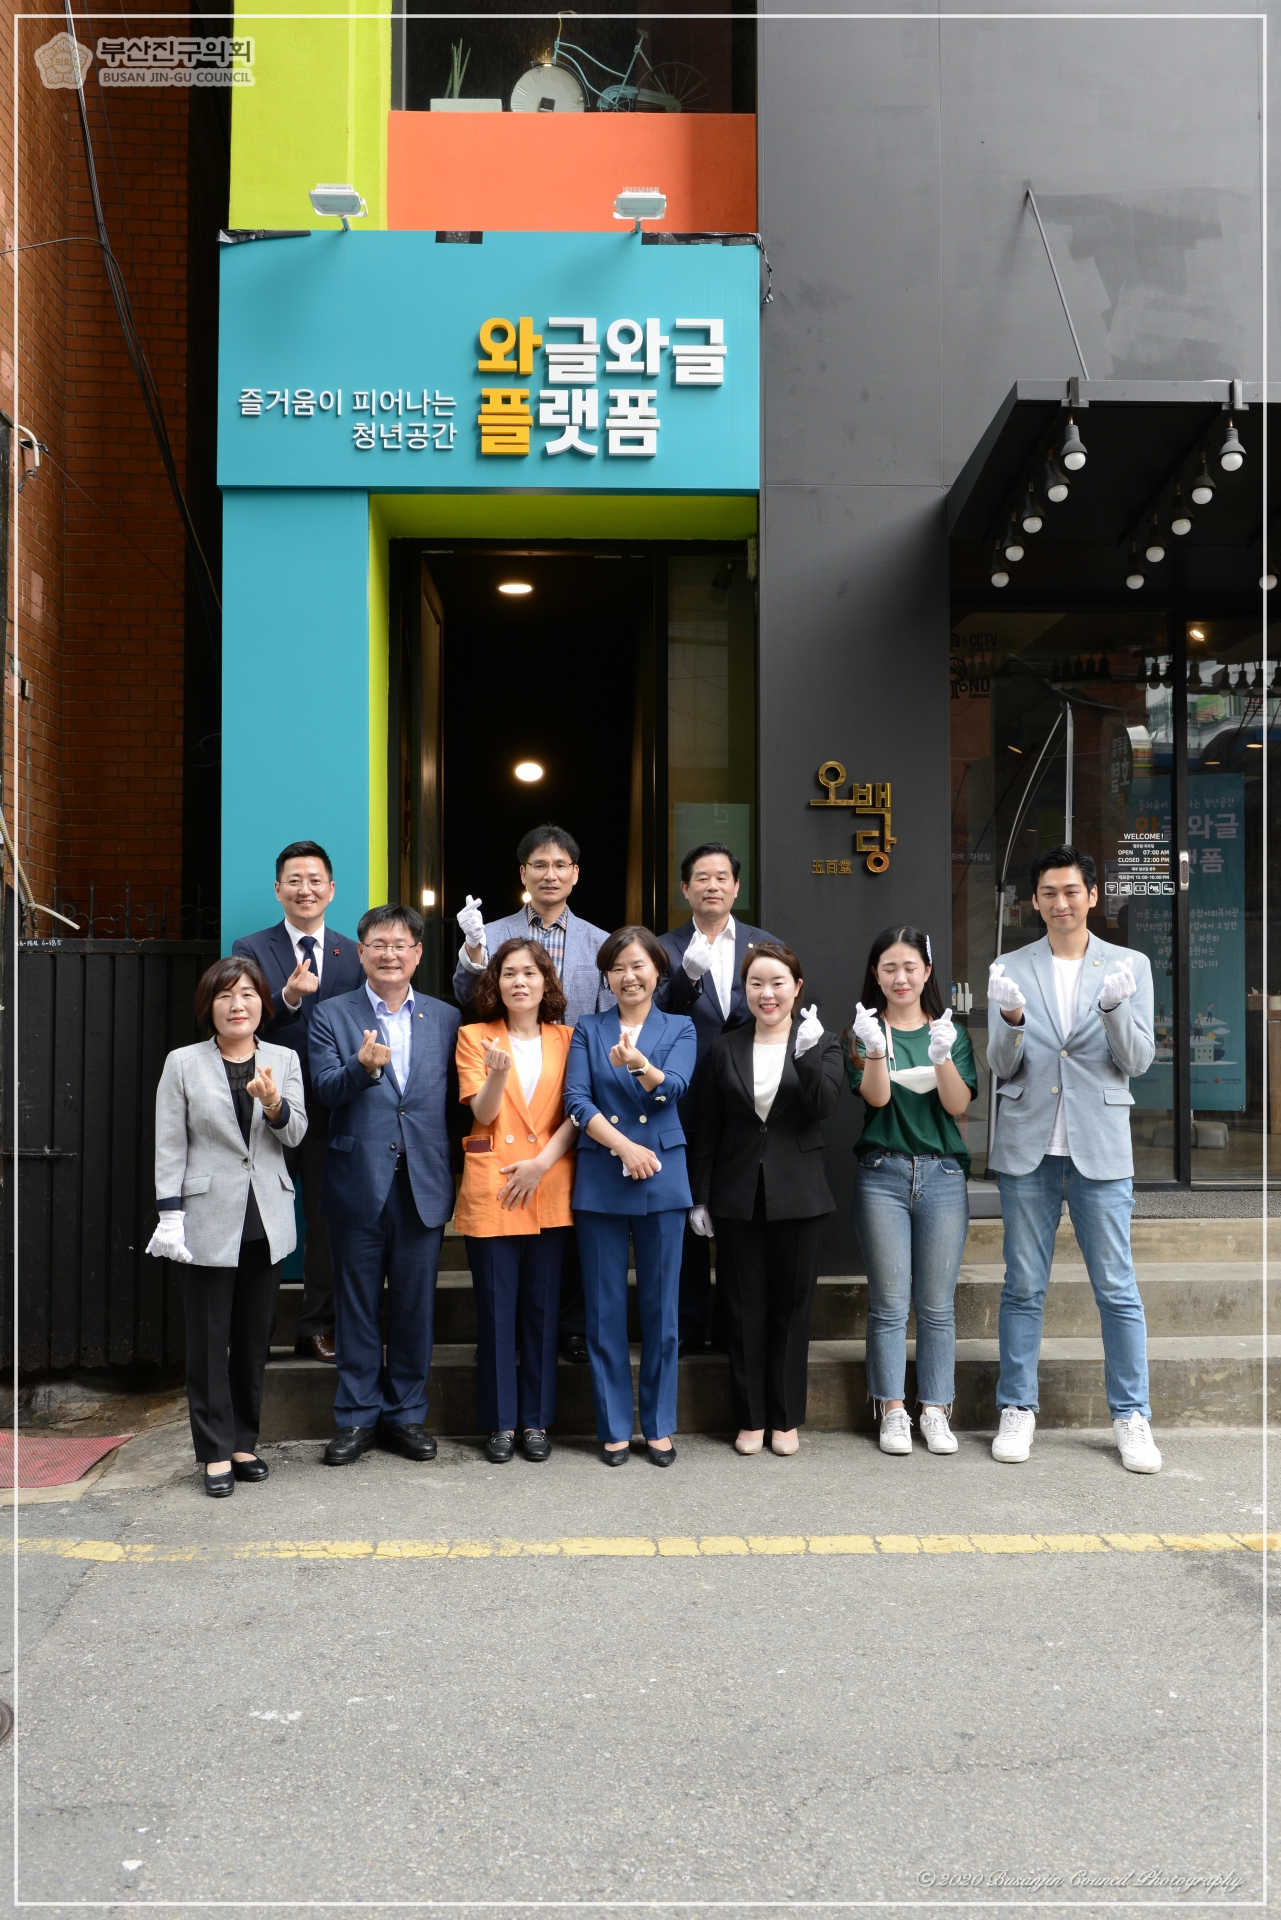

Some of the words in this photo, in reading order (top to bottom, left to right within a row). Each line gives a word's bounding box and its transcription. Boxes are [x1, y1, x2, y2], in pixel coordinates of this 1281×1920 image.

[478, 316, 728, 386] 와글와글
[238, 388, 342, 418] 즐거움이
[353, 388, 458, 418] 피어나는
[478, 387, 661, 457] 플랫폼
[352, 422, 458, 451] 청년공간
[969, 633, 998, 648] CCTV
[969, 676, 991, 693] NO
[1138, 799, 1168, 812] 즐거움이
[1204, 797, 1235, 809] 청년공간
[969, 852, 991, 862] 화장실
[1217, 922, 1237, 931] 조성한
